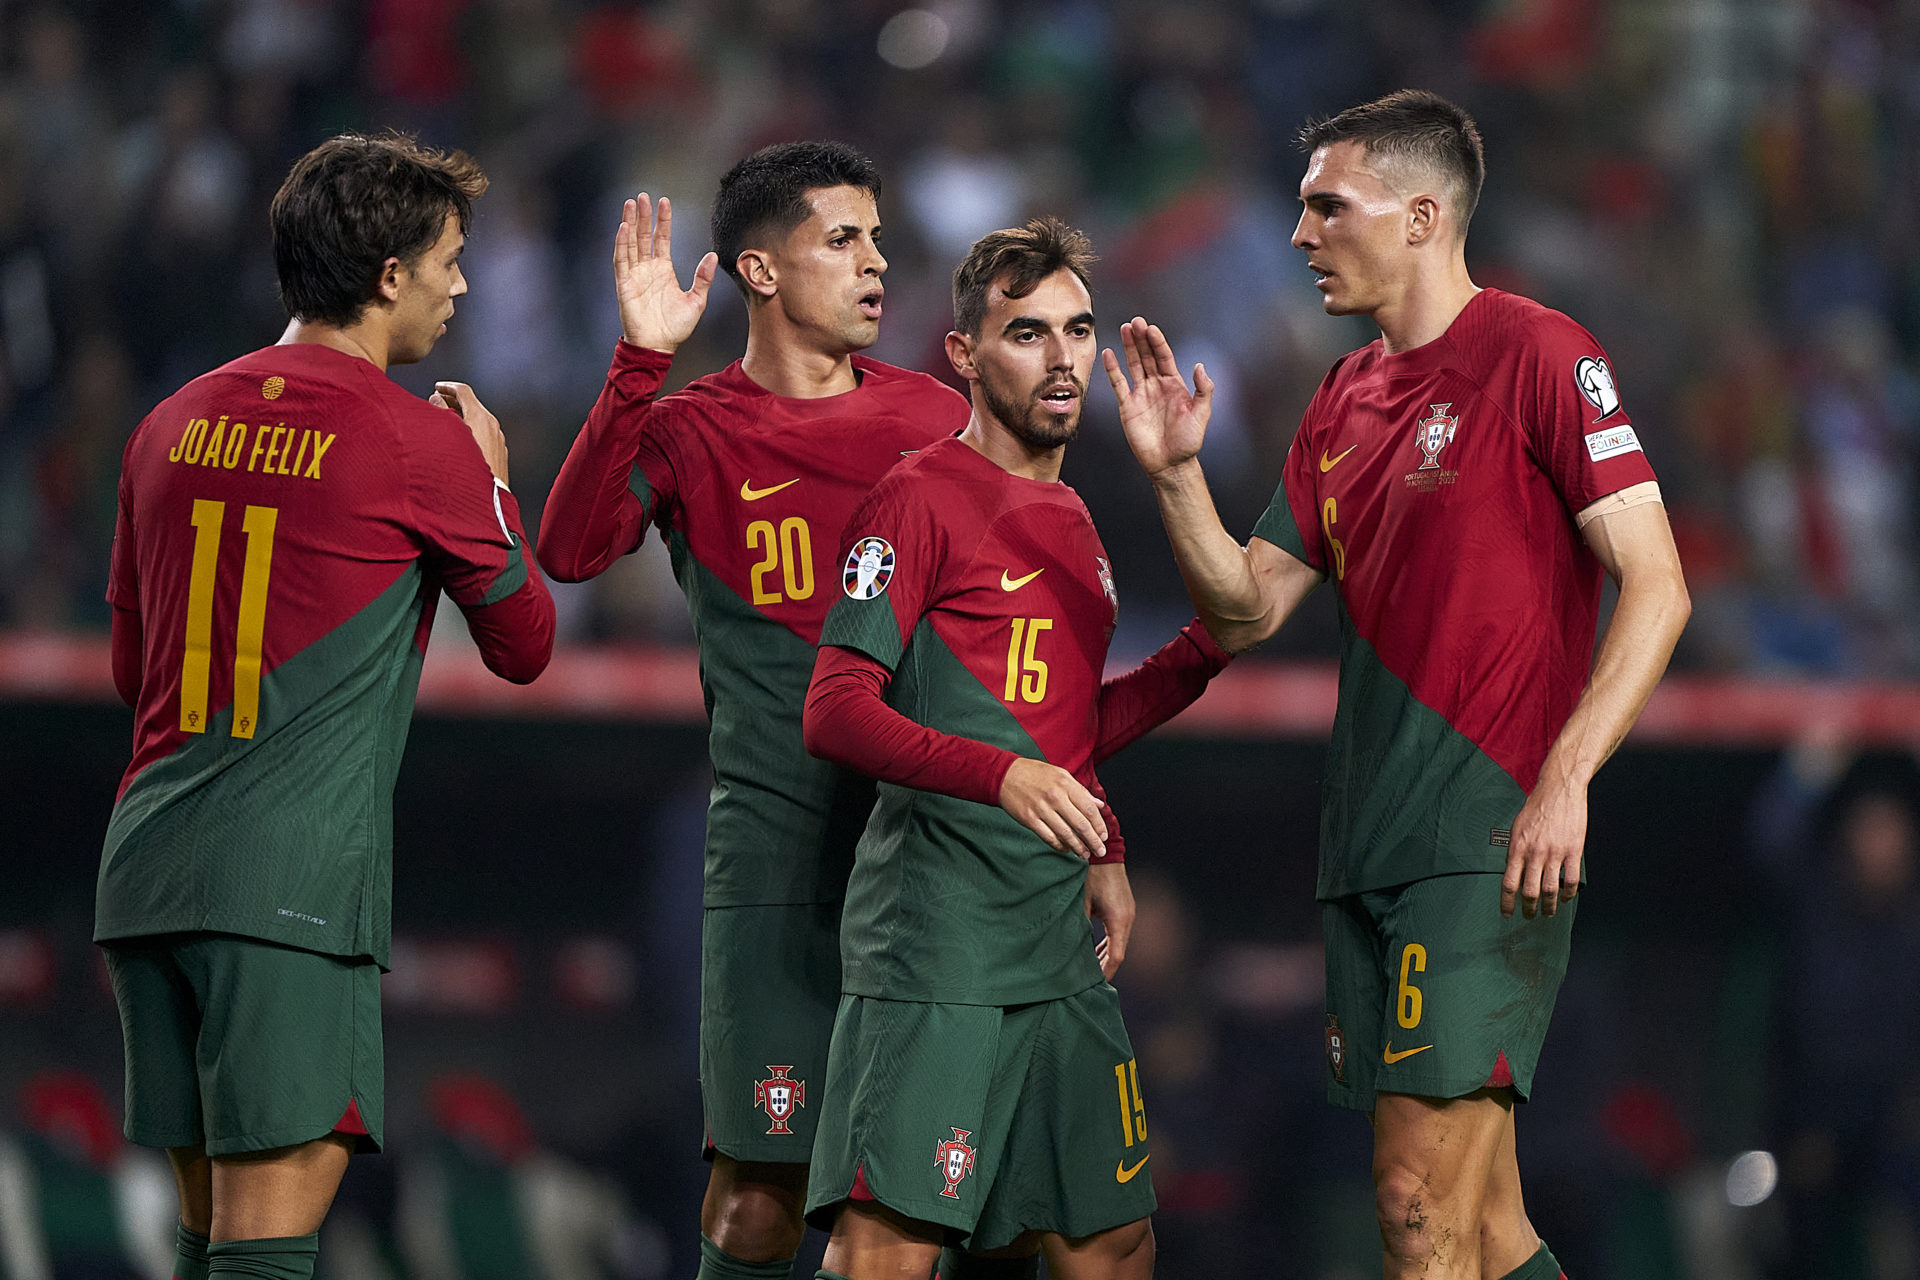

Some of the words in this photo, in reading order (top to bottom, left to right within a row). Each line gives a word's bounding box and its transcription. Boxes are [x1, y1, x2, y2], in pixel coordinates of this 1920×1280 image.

[168, 414, 248, 470] JOÃO
[247, 421, 337, 480] FÉLIX
[746, 516, 815, 606] 20
[1323, 497, 1345, 581] 6
[179, 498, 279, 740] 11
[1004, 617, 1053, 704] 15
[1397, 942, 1427, 1030] 6
[1114, 1057, 1148, 1148] 15
